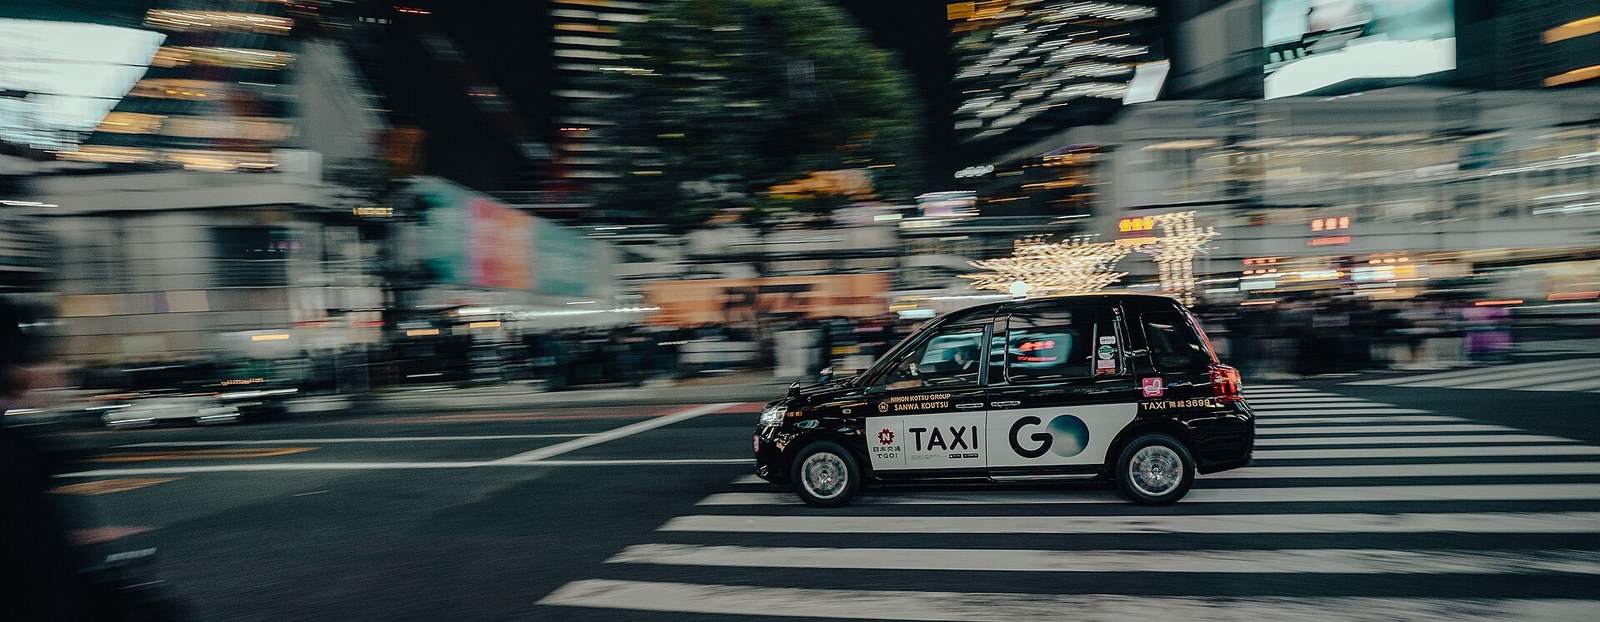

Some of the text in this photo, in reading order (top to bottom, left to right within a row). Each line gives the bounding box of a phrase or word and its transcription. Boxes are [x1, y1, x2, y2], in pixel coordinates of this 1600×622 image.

[894, 401, 949, 411] SANWA KOUTSU
[908, 426, 978, 452] TAXI
[1009, 414, 1090, 458] GO
